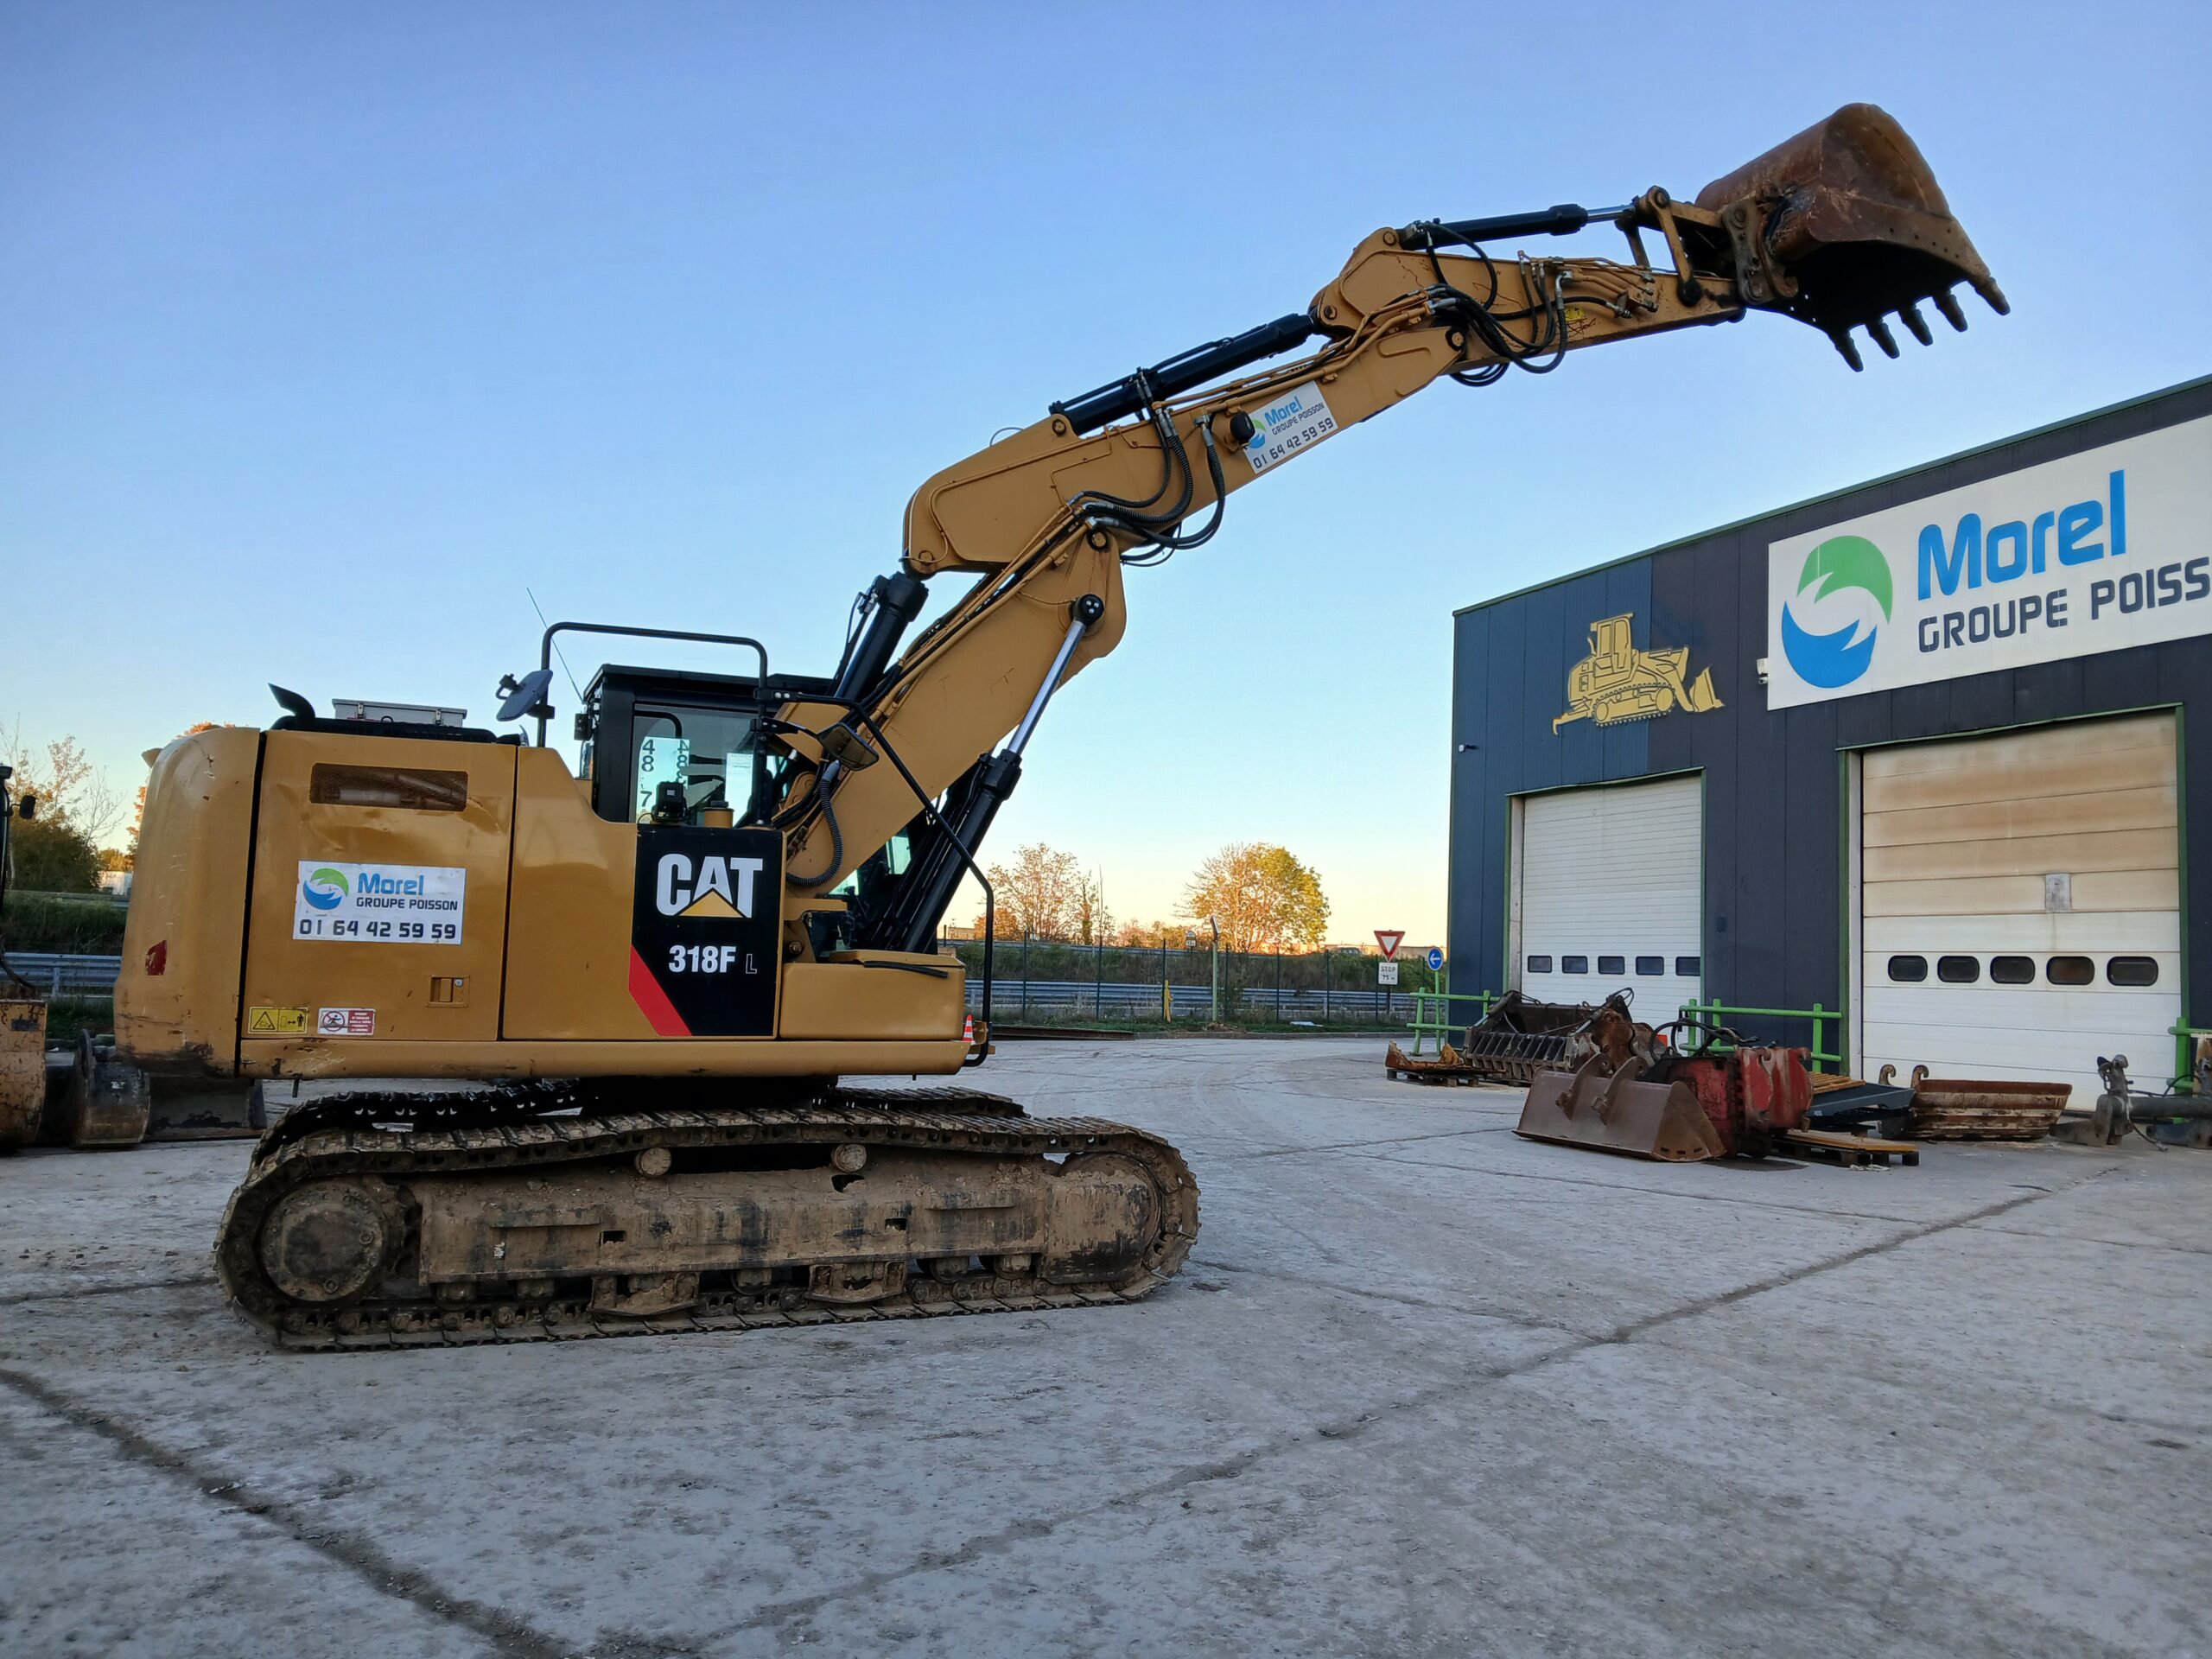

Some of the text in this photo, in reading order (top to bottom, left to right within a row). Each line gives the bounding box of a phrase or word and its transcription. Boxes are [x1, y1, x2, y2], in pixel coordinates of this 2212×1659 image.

[1264, 396, 1303, 427] Morel
[1271, 402, 1325, 435] GROUPE POISSON
[1253, 417, 1334, 469] 01 64 42 59 59
[1917, 469, 2126, 601] Morel
[1918, 556, 2212, 653] GROUPE POISS
[357, 872, 424, 896] Morel
[656, 853, 764, 918] CAT
[356, 896, 458, 911] GROUPE POISSON
[299, 918, 456, 939] 01 64 42 59 59
[668, 944, 758, 975] 318F L
